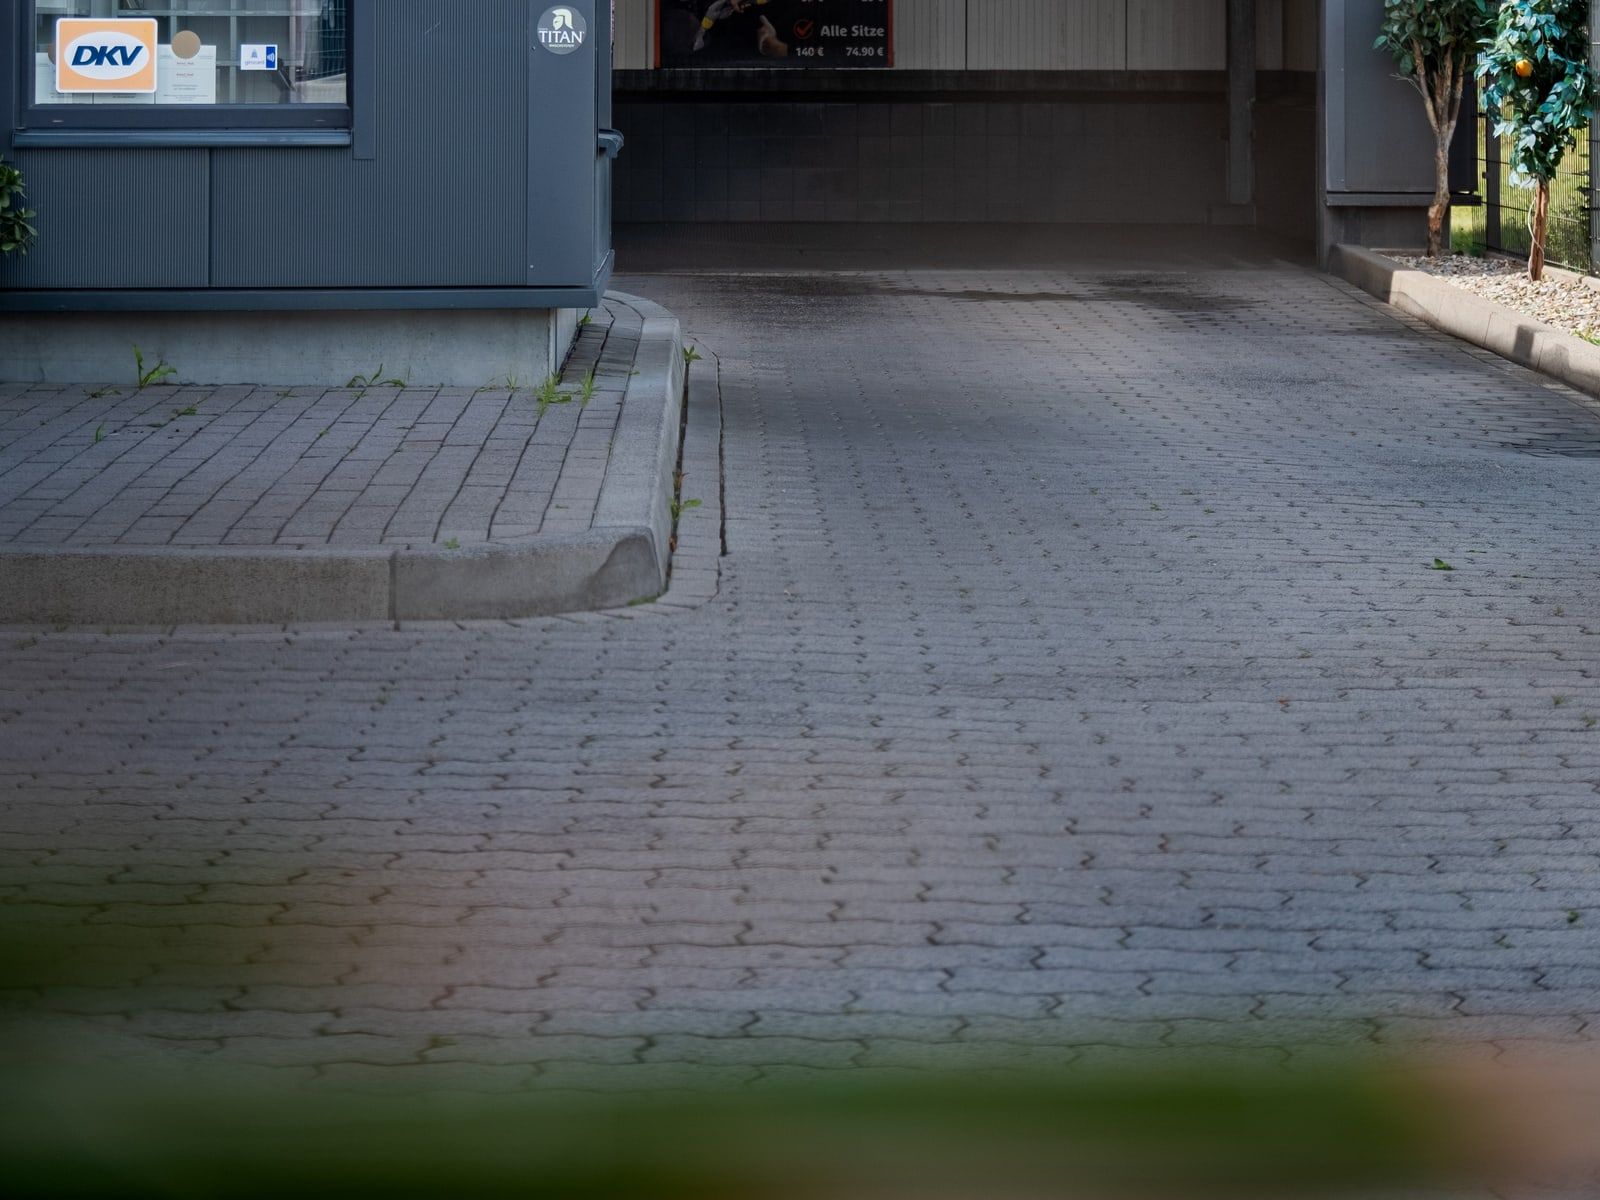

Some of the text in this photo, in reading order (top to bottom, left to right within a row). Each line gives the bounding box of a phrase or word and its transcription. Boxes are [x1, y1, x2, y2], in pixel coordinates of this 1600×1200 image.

[538, 30, 583, 44] TITAN
[820, 25, 885, 37] Alle Sitze
[71, 45, 144, 66] DKV
[796, 47, 824, 56] 140 €
[846, 47, 884, 56] 74.90 €
